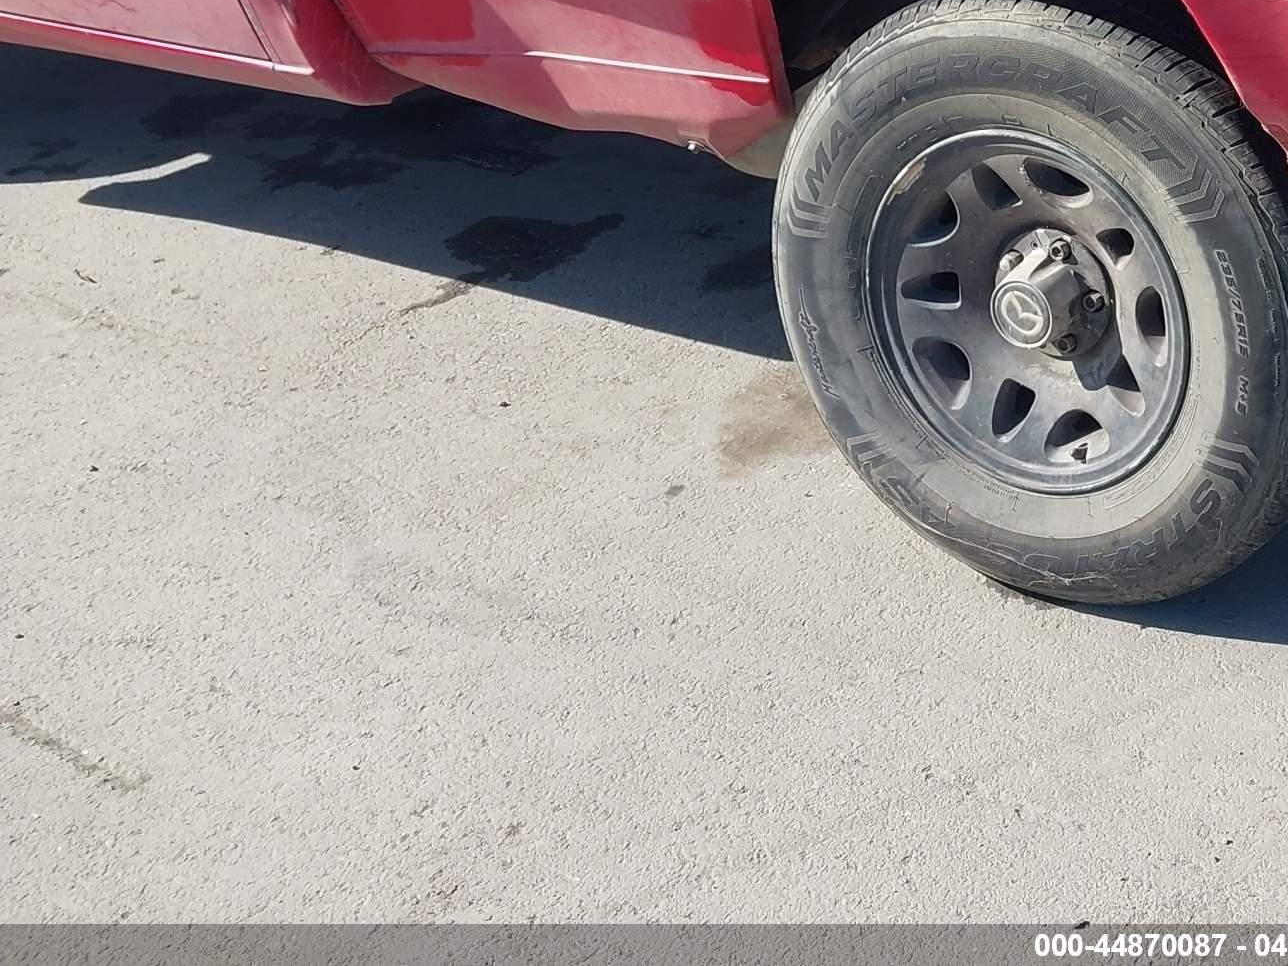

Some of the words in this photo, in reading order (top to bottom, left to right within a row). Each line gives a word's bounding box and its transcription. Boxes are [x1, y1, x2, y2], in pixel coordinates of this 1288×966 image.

[805, 53, 1188, 202] MASTERCRAFT
[1213, 248, 1250, 359] 235/75R15
[1234, 373, 1250, 418] M+S
